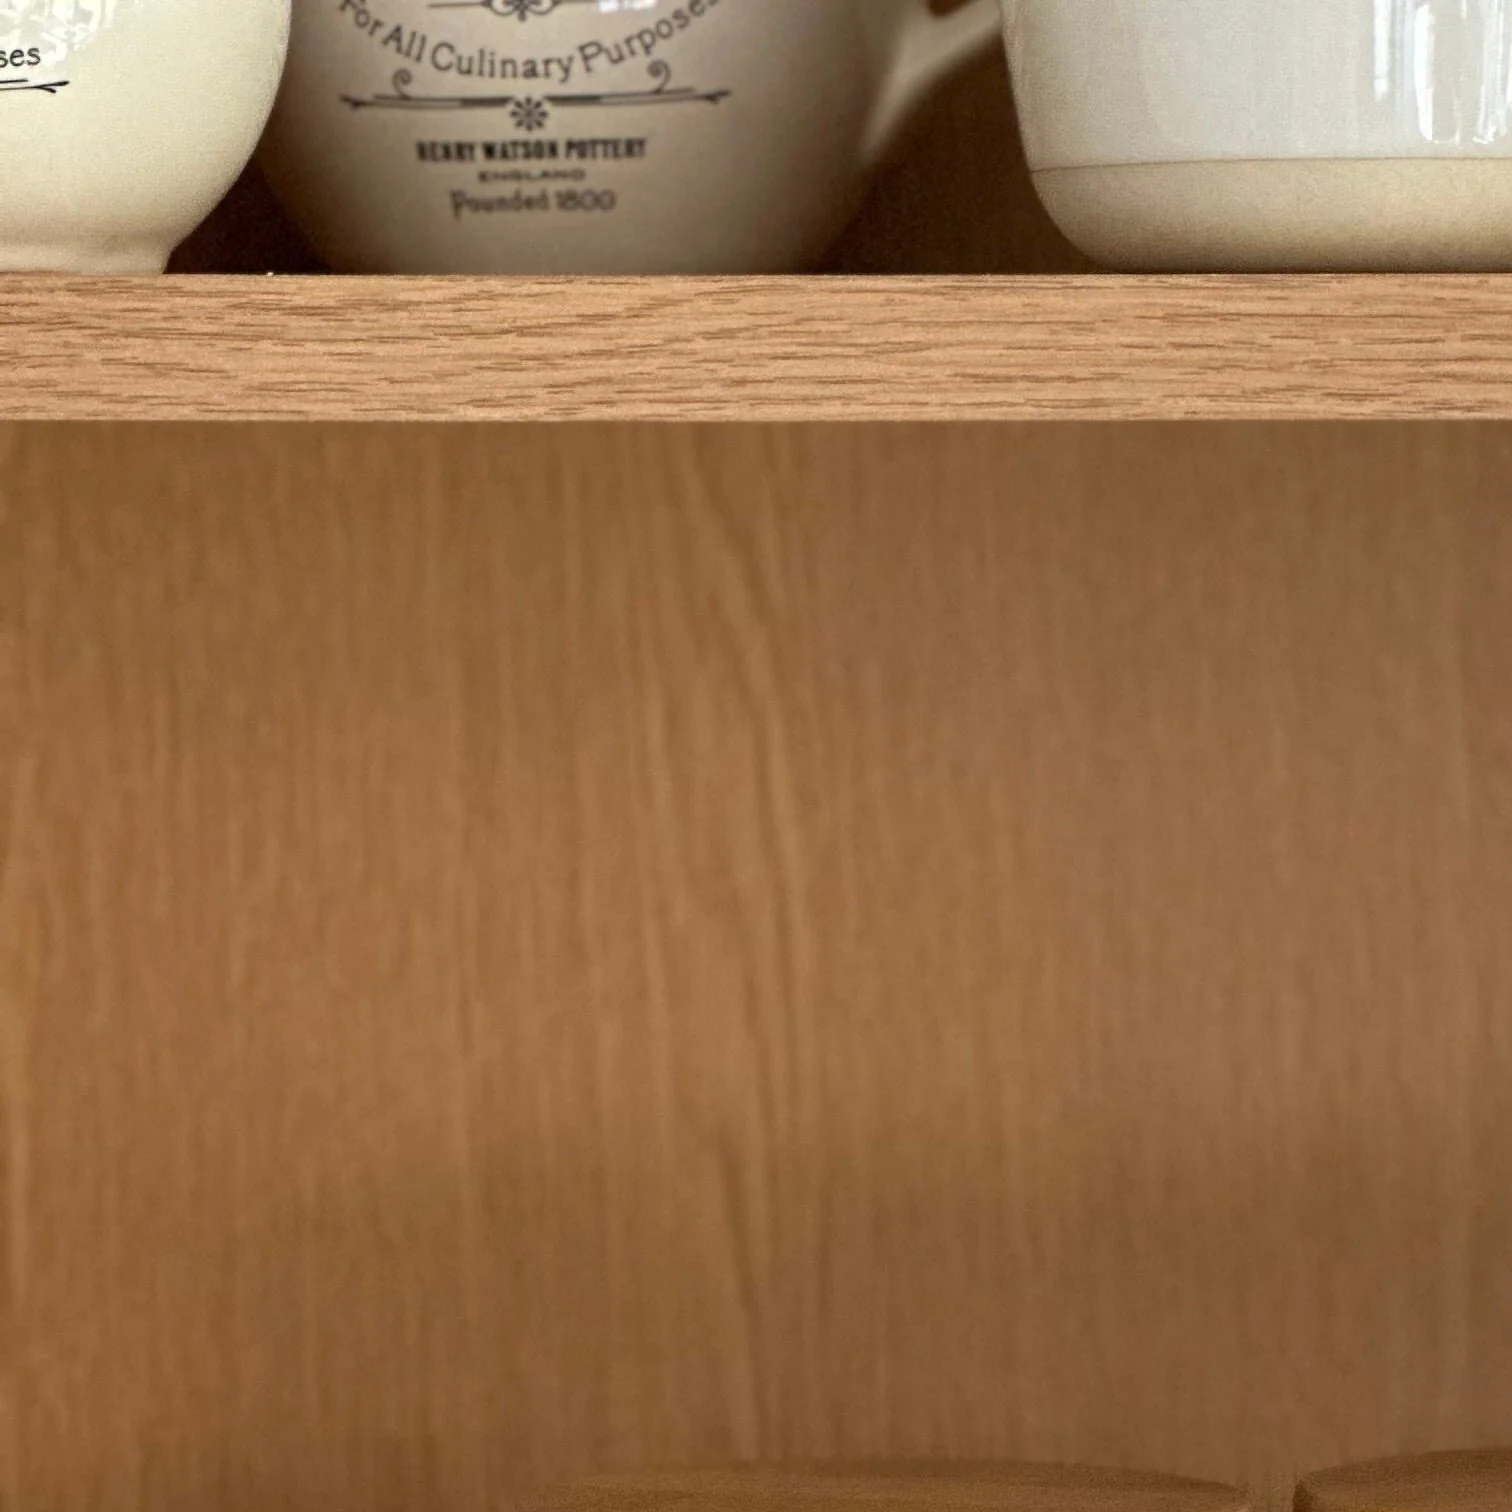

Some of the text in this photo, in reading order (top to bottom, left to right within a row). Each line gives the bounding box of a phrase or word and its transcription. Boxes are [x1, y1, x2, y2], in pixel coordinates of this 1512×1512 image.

[381, 24, 428, 63] All
[431, 41, 574, 83] Culinary
[578, 0, 720, 73] Purpose
[416, 137, 647, 162] HENRY WATSON POTTERY
